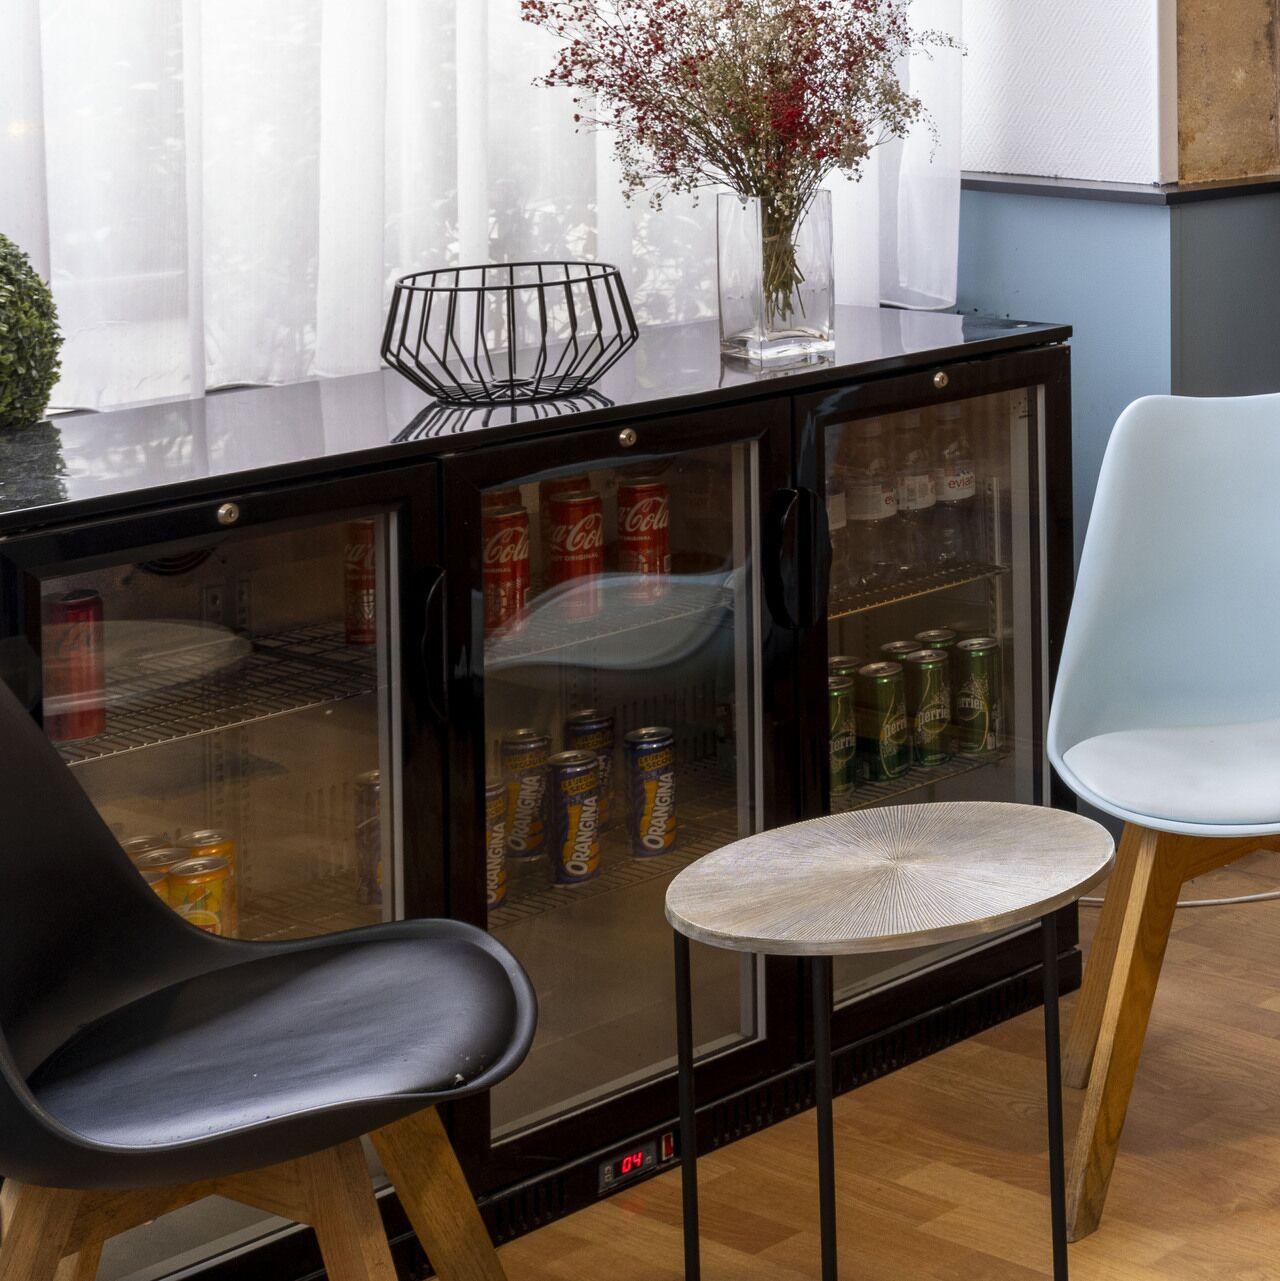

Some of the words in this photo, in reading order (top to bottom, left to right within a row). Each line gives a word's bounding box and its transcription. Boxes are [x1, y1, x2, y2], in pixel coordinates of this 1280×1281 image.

[508, 775, 541, 851] ORANGINA
[565, 795, 598, 876] ORANGINA
[642, 771, 674, 850] ORANGINA
[621, 1151, 644, 1175] 04
